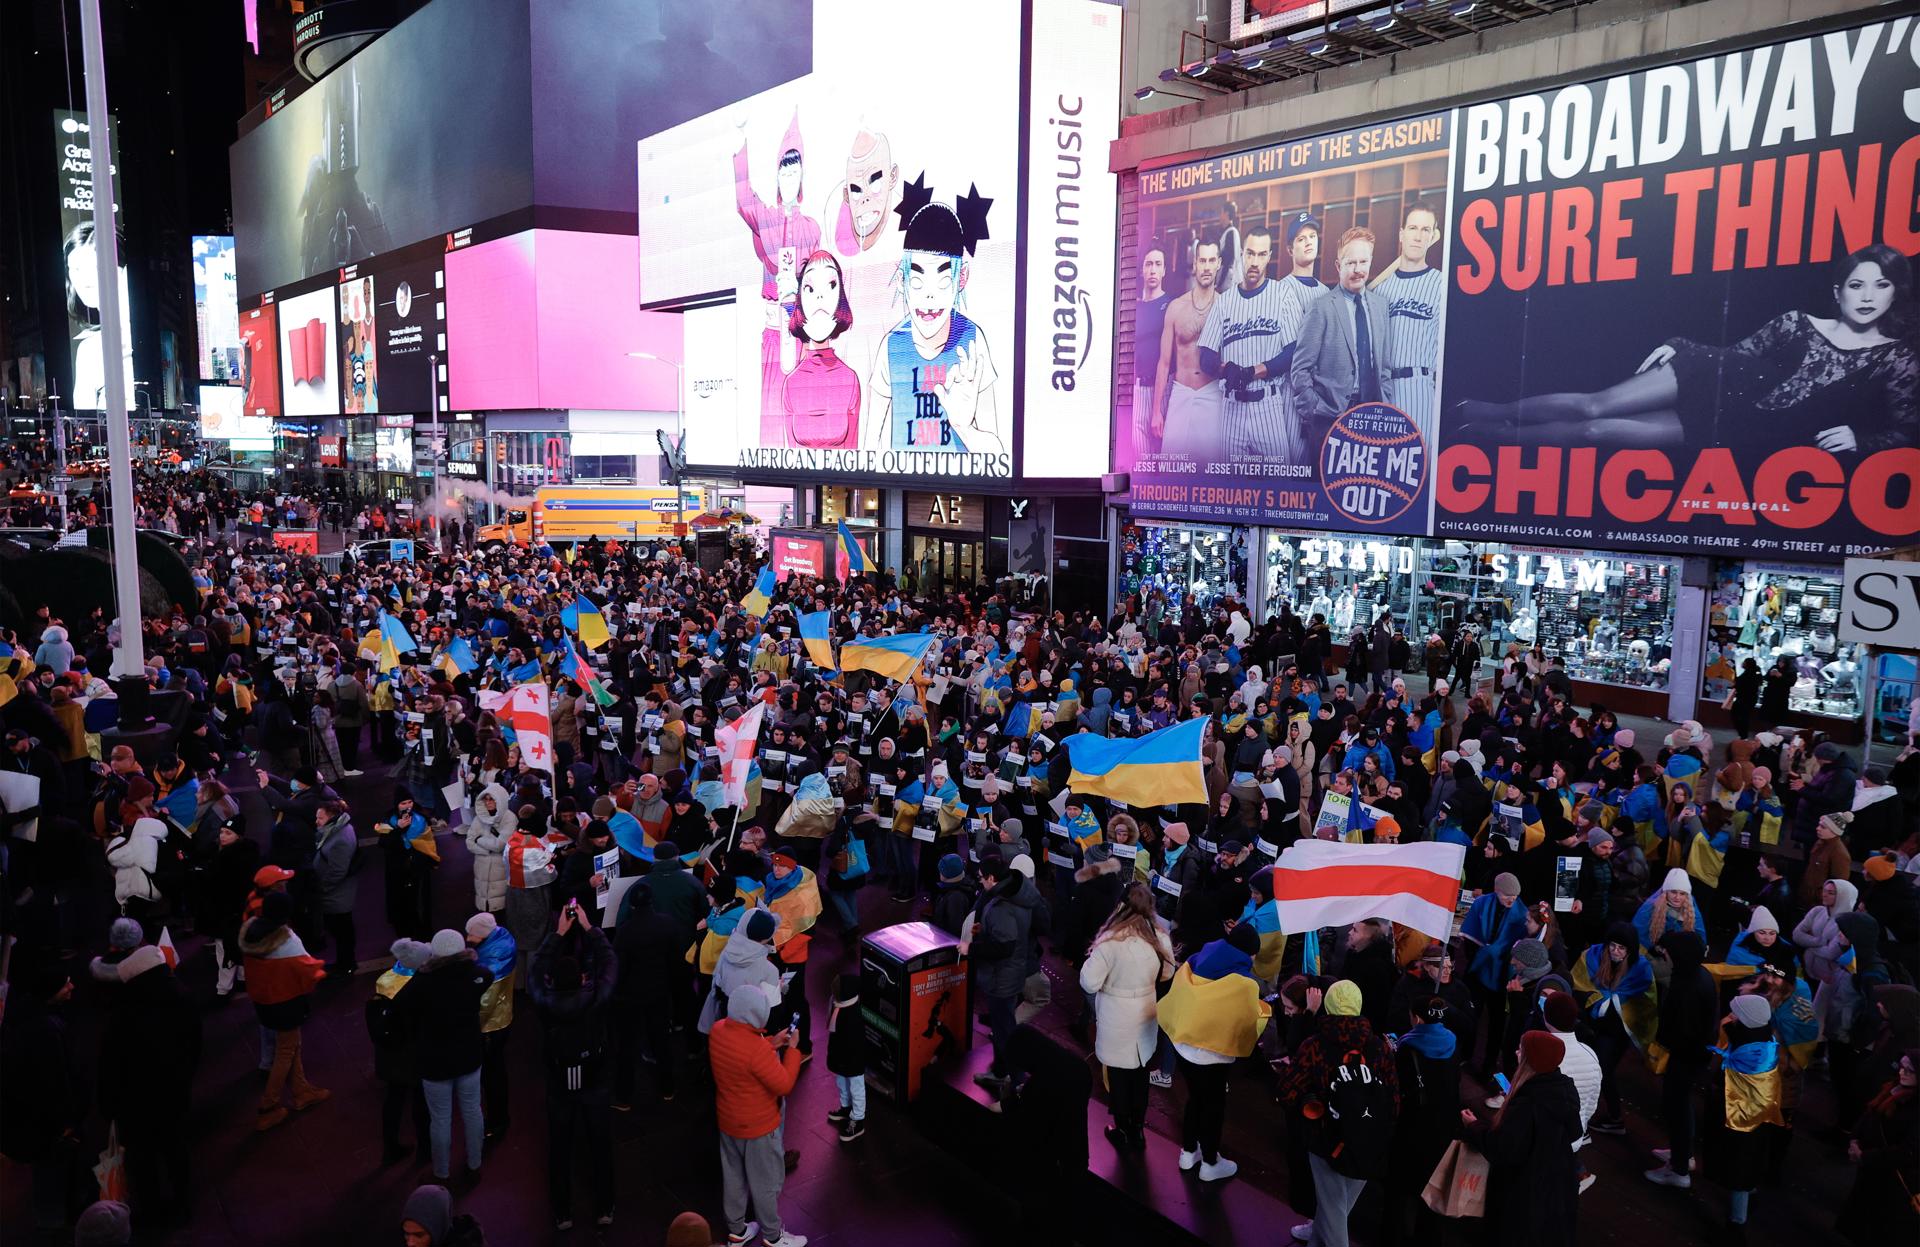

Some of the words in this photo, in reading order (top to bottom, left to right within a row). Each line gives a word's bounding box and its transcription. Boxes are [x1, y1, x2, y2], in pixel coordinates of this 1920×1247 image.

[295, 10, 324, 33] MARRIOTT
[296, 25, 320, 47] MARQUIS
[1049, 94, 1083, 226] music
[1141, 171, 1167, 195] THE
[1171, 154, 1254, 189] HOME-RUN
[1259, 147, 1283, 173] HIT
[1290, 143, 1312, 167] OF
[1319, 135, 1351, 161] THE
[1358, 117, 1442, 156] SEASON!
[1457, 177, 1643, 295] SURE
[1664, 135, 1920, 275] THING
[1051, 236, 1079, 392] amazon
[1223, 315, 1279, 338] Empires
[693, 378, 723, 391] amazon
[912, 366, 919, 394] I
[921, 363, 948, 392] AM
[913, 392, 944, 419] THE
[907, 419, 951, 447] LAMB
[1348, 419, 1368, 430] BEST
[1372, 421, 1408, 434] REVIVAL
[447, 462, 477, 475] SEPHORA
[738, 448, 816, 470] AMERICAN
[823, 450, 876, 472] EAGLE
[882, 450, 1010, 478] OUTFITTERS
[1133, 461, 1156, 472] JESSE
[1158, 462, 1197, 474] WILLIAMS
[1204, 462, 1231, 475] JESSE
[1233, 463, 1261, 475] TYLER
[1262, 464, 1312, 478] FERGUSON
[1230, 454, 1242, 462] TONY
[1243, 455, 1262, 463] AWARD
[1264, 455, 1285, 463] WINNER
[1327, 436, 1381, 476] TAKE
[1385, 446, 1422, 487] ME
[1132, 484, 1187, 502] THROUGH
[1192, 487, 1261, 507] FEBRUARY
[1265, 490, 1274, 507] 5
[1279, 491, 1317, 509] ONLY
[1341, 485, 1391, 517] OUT
[1436, 444, 1920, 536] CHICAGO
[928, 495, 962, 525] AE
[1137, 502, 1156, 511] GERALD
[1157, 503, 1189, 512] SCHOENFELD
[1214, 506, 1225, 514] 236
[1234, 507, 1249, 516] 45TH
[1264, 510, 1329, 522] TAKEMEOUTBWAY.COM
[1682, 500, 1710, 509] THE
[1717, 501, 1790, 512] MUSICAL
[1439, 521, 1593, 539] CHICAGOTHEMUSICAL.COM
[1615, 532, 1689, 545] AMBASSADOR
[1693, 536, 1740, 548] THEATRE
[1752, 539, 1778, 549] 49TH
[1782, 540, 1824, 553] STREET
[1828, 544, 1841, 553] AT
[1146, 562, 1152, 572] 2
[1300, 538, 1414, 574] GRAND
[1491, 554, 1607, 593] SLAM
[1328, 793, 1339, 803] TO
